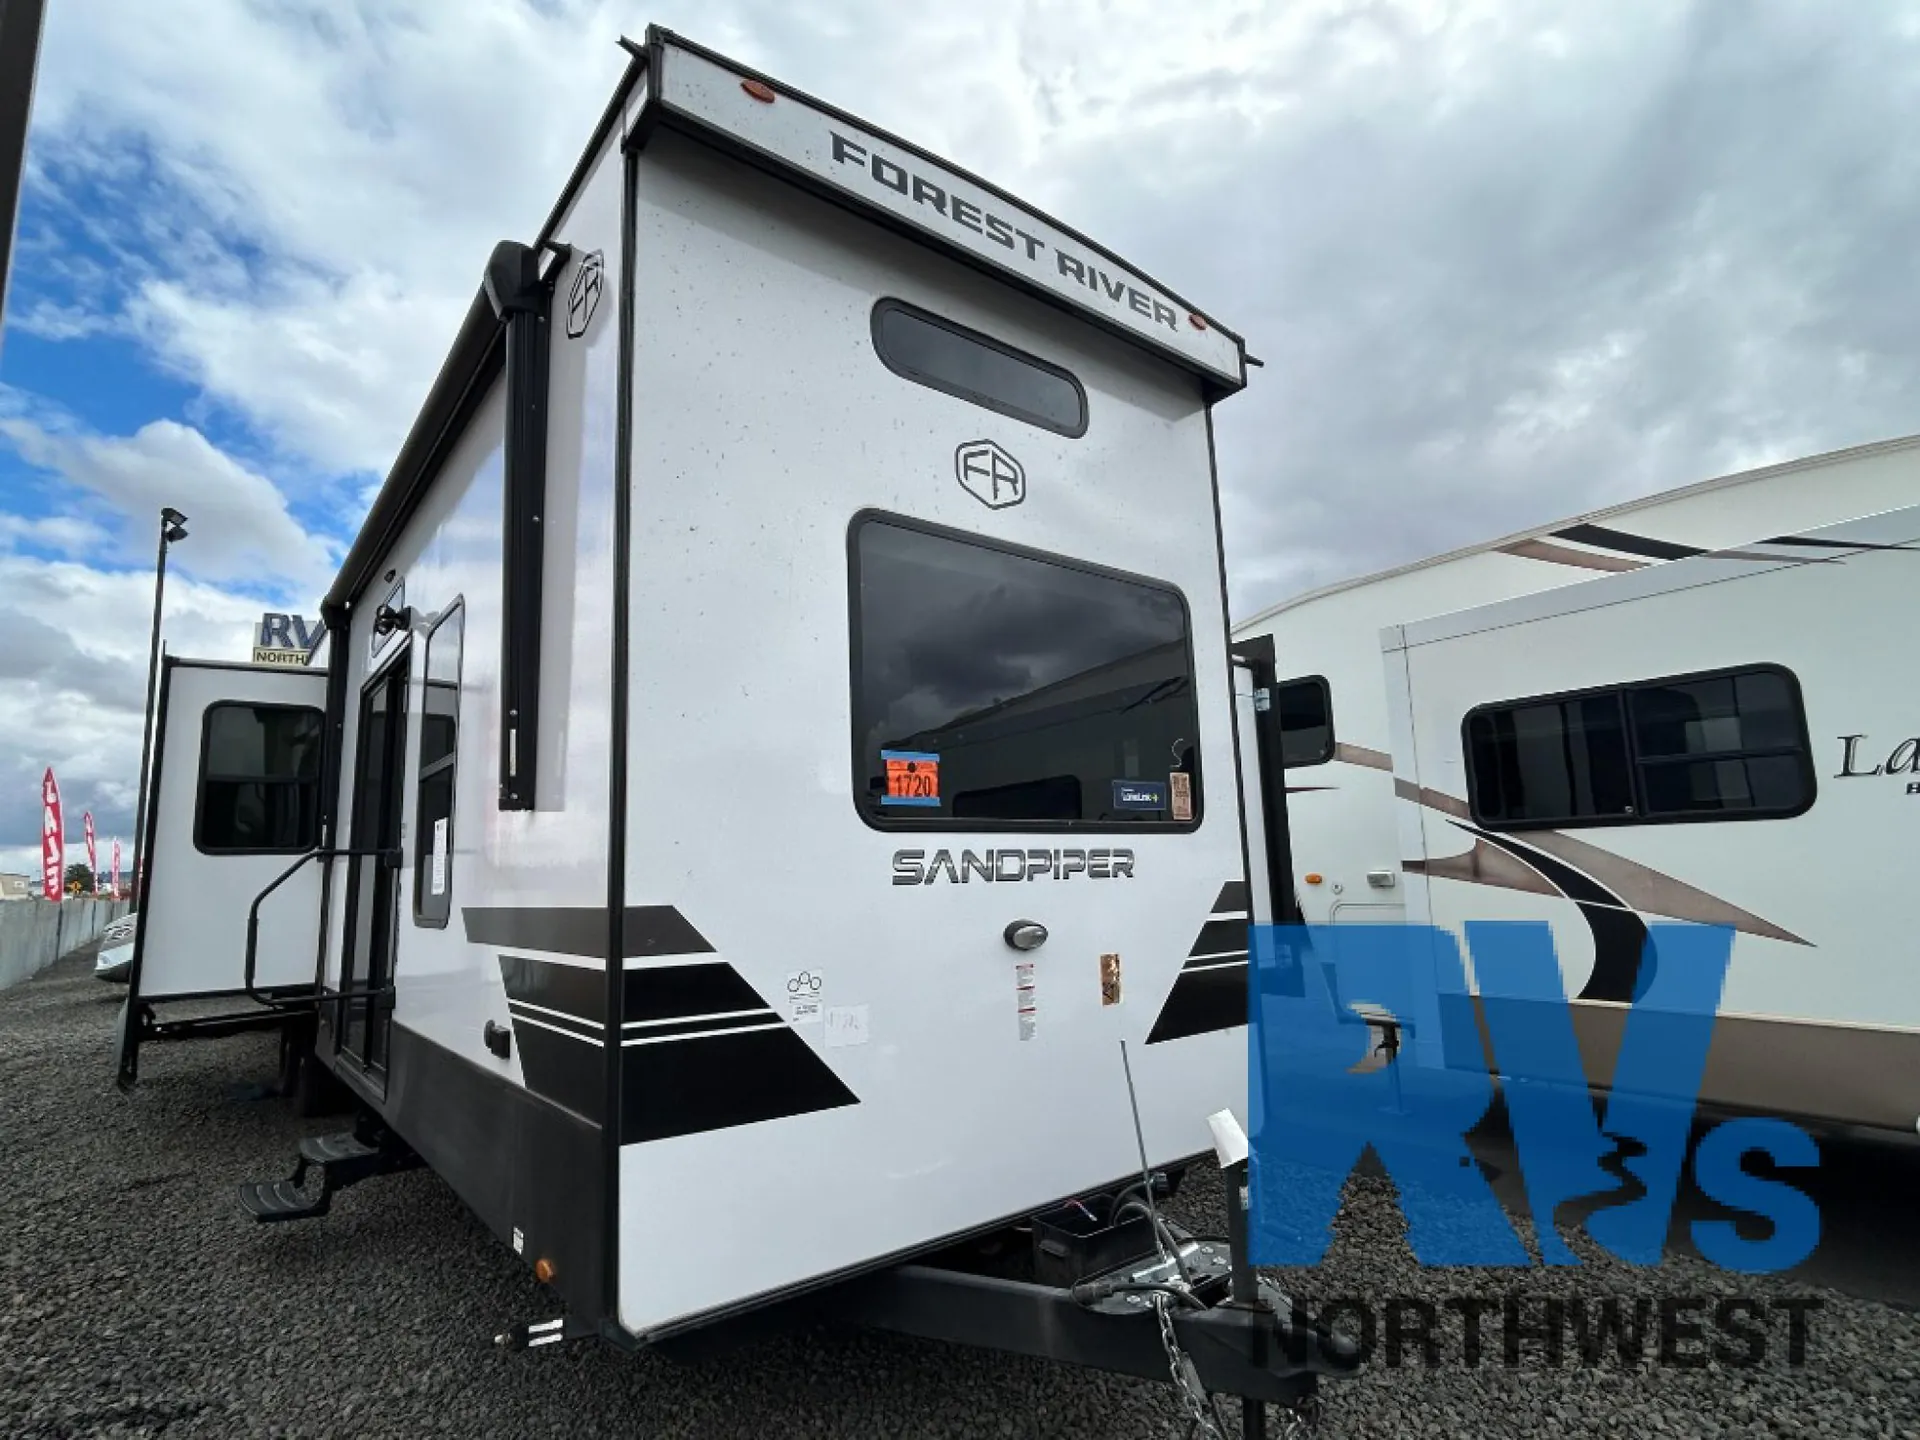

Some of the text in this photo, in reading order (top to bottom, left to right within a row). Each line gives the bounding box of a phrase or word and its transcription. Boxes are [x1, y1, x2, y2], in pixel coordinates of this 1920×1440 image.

[830, 130, 1178, 332] FOREST RIVER
[896, 774, 931, 797] 1720
[892, 848, 1135, 885] SANDPIPER
